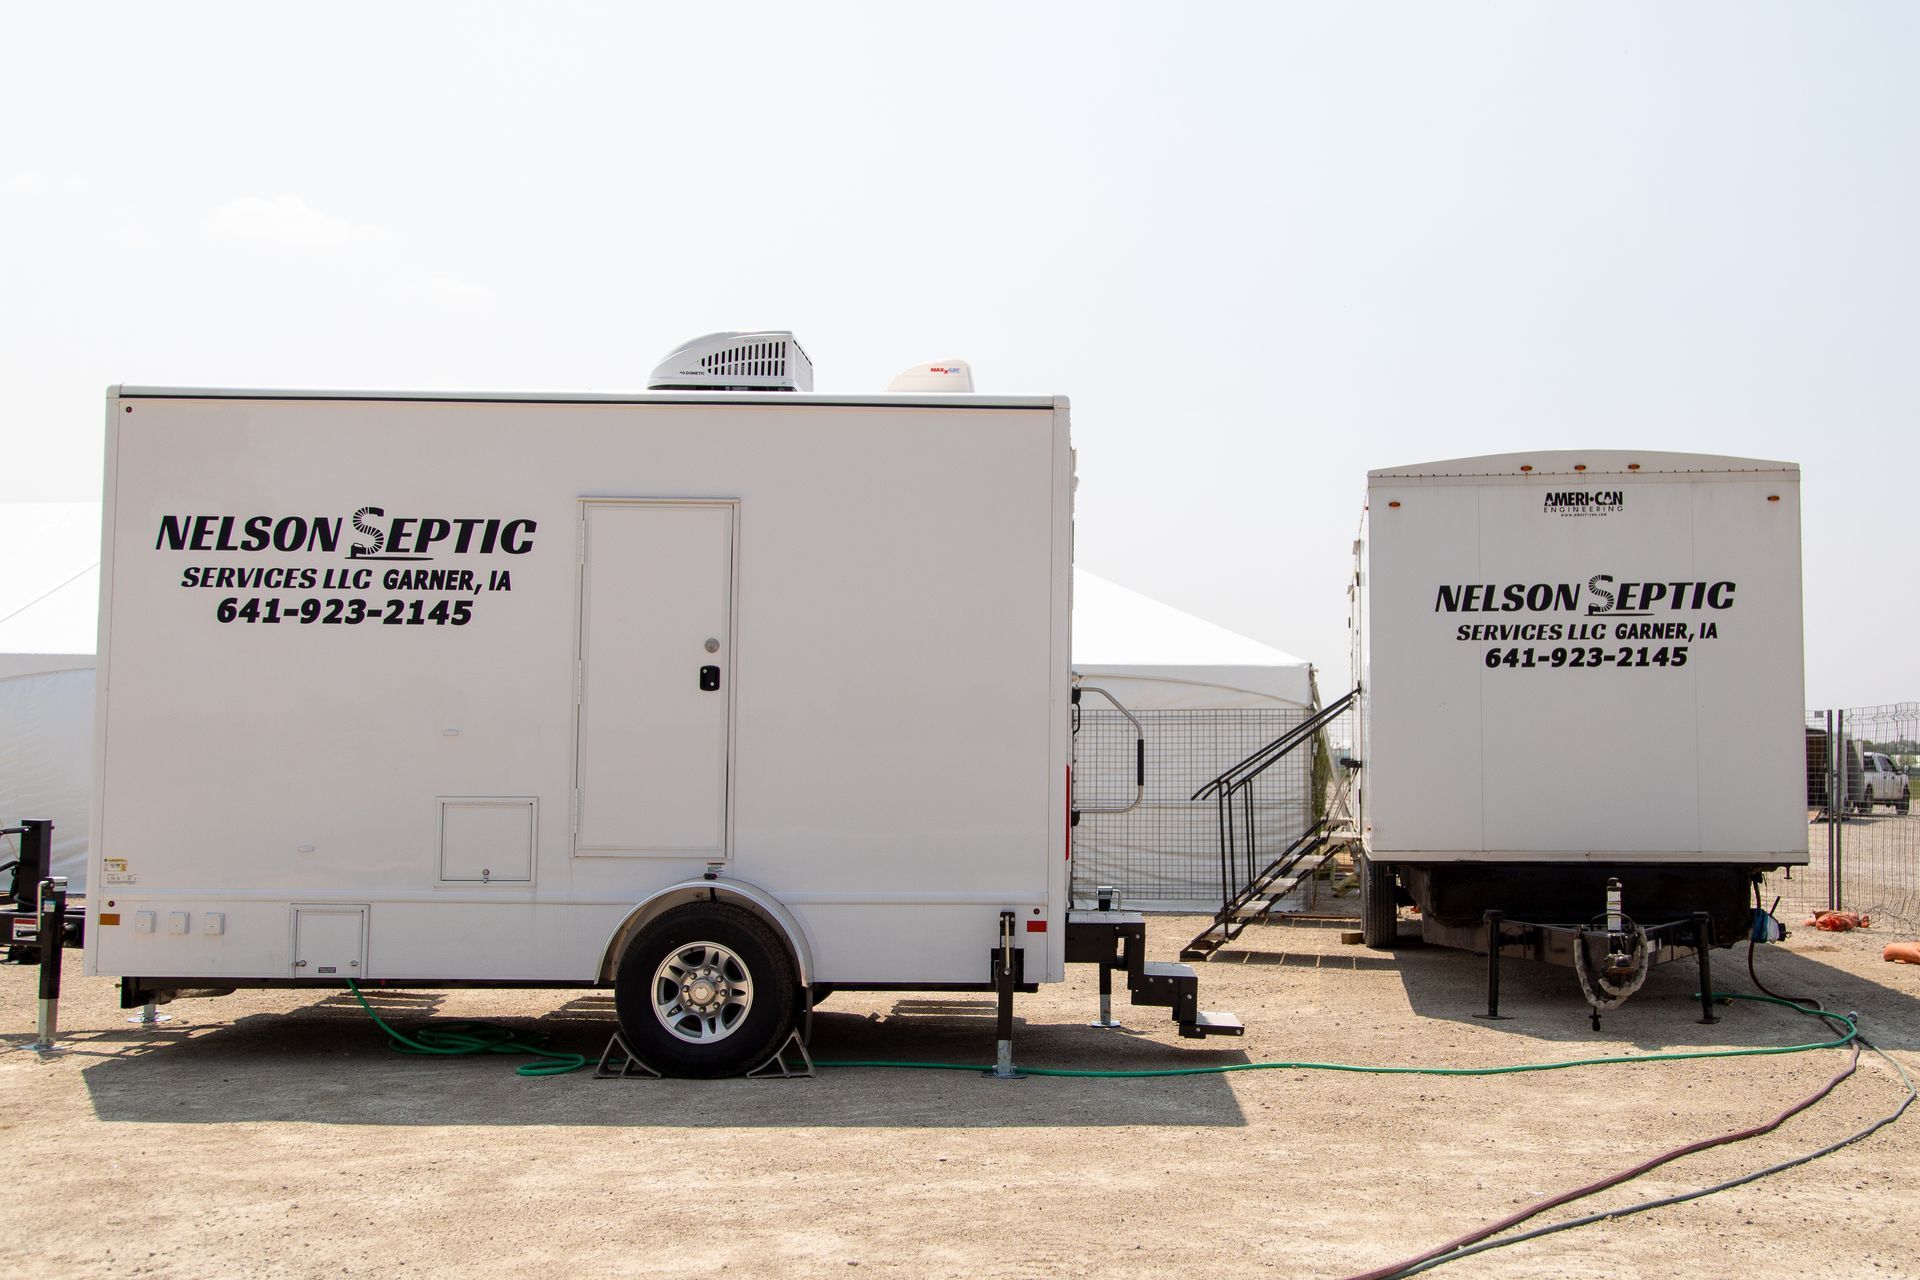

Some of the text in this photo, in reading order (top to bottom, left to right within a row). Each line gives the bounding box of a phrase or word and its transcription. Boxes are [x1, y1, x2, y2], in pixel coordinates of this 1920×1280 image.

[1543, 505, 1624, 513] ENGINEERING
[156, 507, 538, 557] NELSON SEPTIC
[181, 567, 512, 595] SERVICES LLC GARNER, IA
[1435, 575, 1737, 616] NELSON SEPTIC
[216, 597, 474, 625] 641-923-2145
[1456, 622, 1718, 642] SERVICES LLC GARNER, IA
[1485, 647, 1689, 668] 641-923-2145
